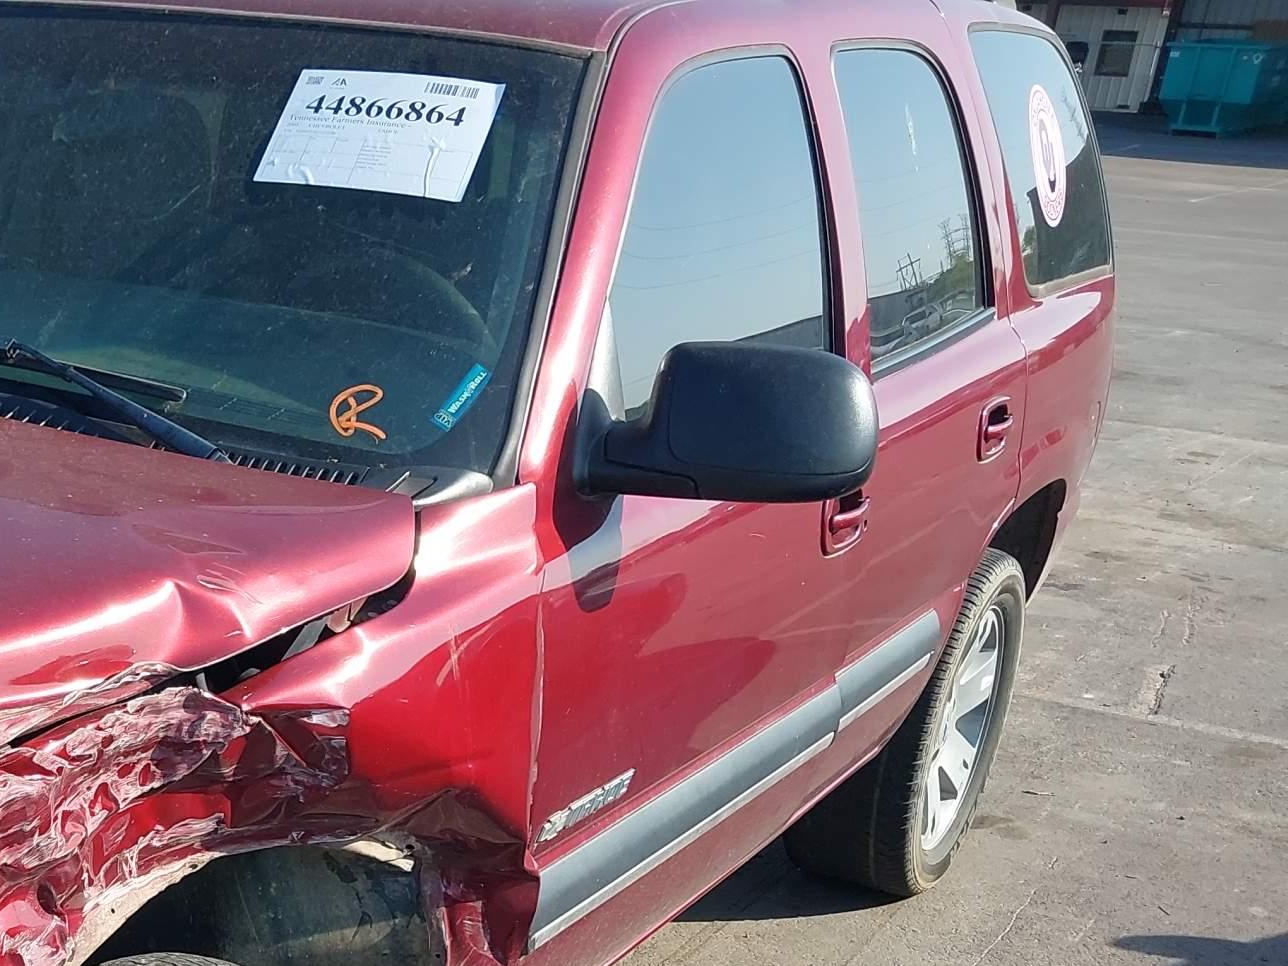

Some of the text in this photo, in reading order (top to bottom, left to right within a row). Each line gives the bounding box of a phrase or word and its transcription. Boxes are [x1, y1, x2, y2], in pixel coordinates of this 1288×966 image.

[289, 113, 328, 123] Tennessee
[331, 115, 363, 125] Farmers
[366, 118, 406, 129] Insurance
[305, 94, 467, 127] 44866864
